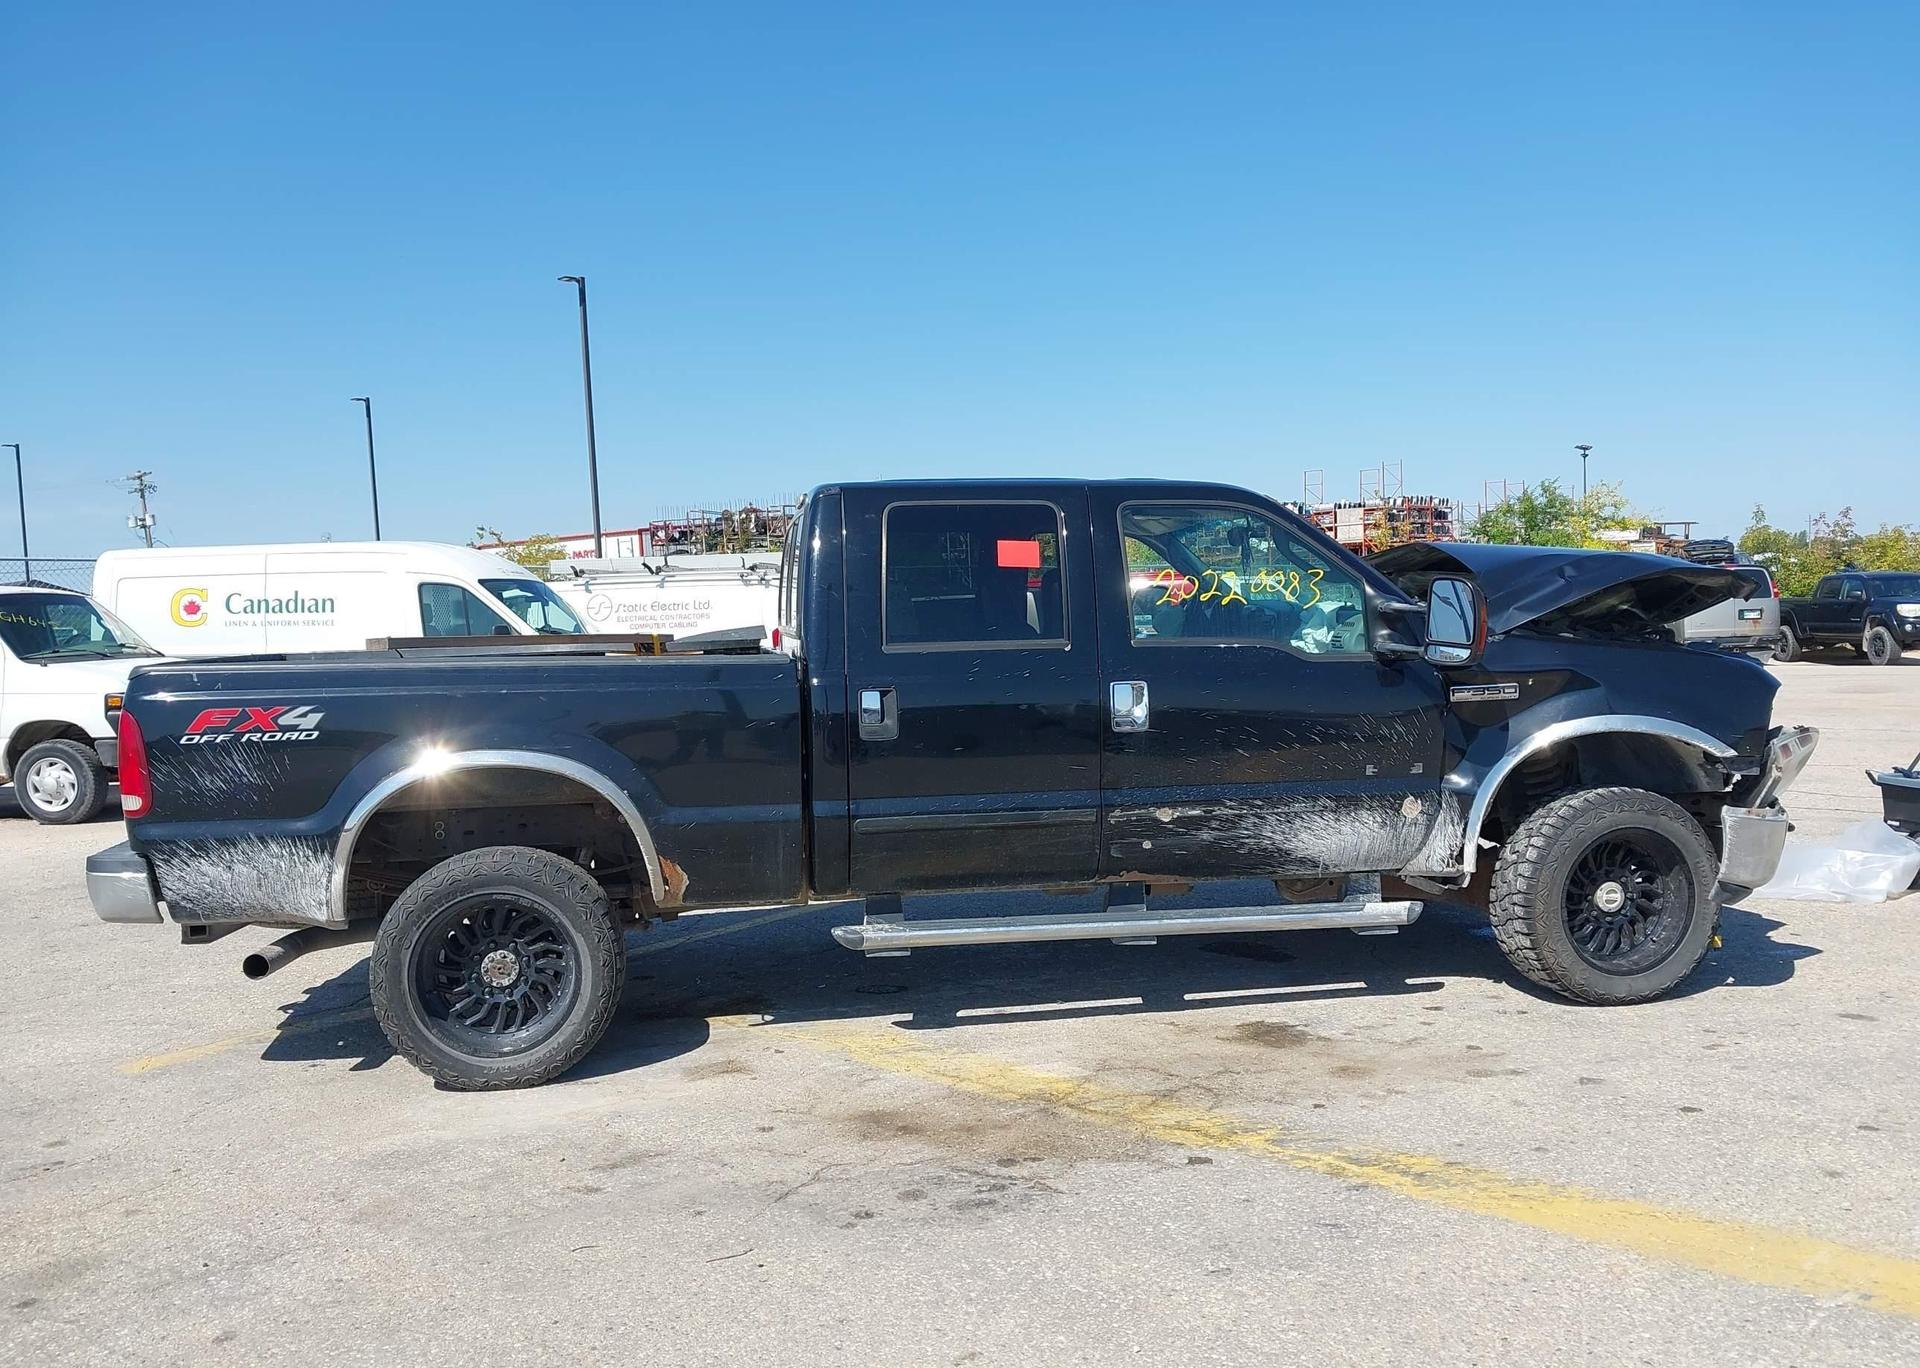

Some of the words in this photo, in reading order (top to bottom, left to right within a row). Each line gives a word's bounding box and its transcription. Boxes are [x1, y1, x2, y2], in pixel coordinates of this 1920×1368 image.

[225, 590, 335, 615] Canadian
[615, 603, 648, 613] Static
[651, 600, 690, 612] Electric
[693, 599, 713, 610] Ltd.
[261, 619, 299, 627] UNIFORM
[302, 619, 335, 627] SERVICE
[617, 614, 658, 623] ELECTRICAL
[660, 612, 710, 621] CONTRACTORS
[629, 622, 666, 630] COMPUTER
[669, 620, 698, 629] CABLING
[185, 704, 326, 734] FX4
[179, 733, 235, 745] OFF
[240, 730, 320, 743] ROAD
